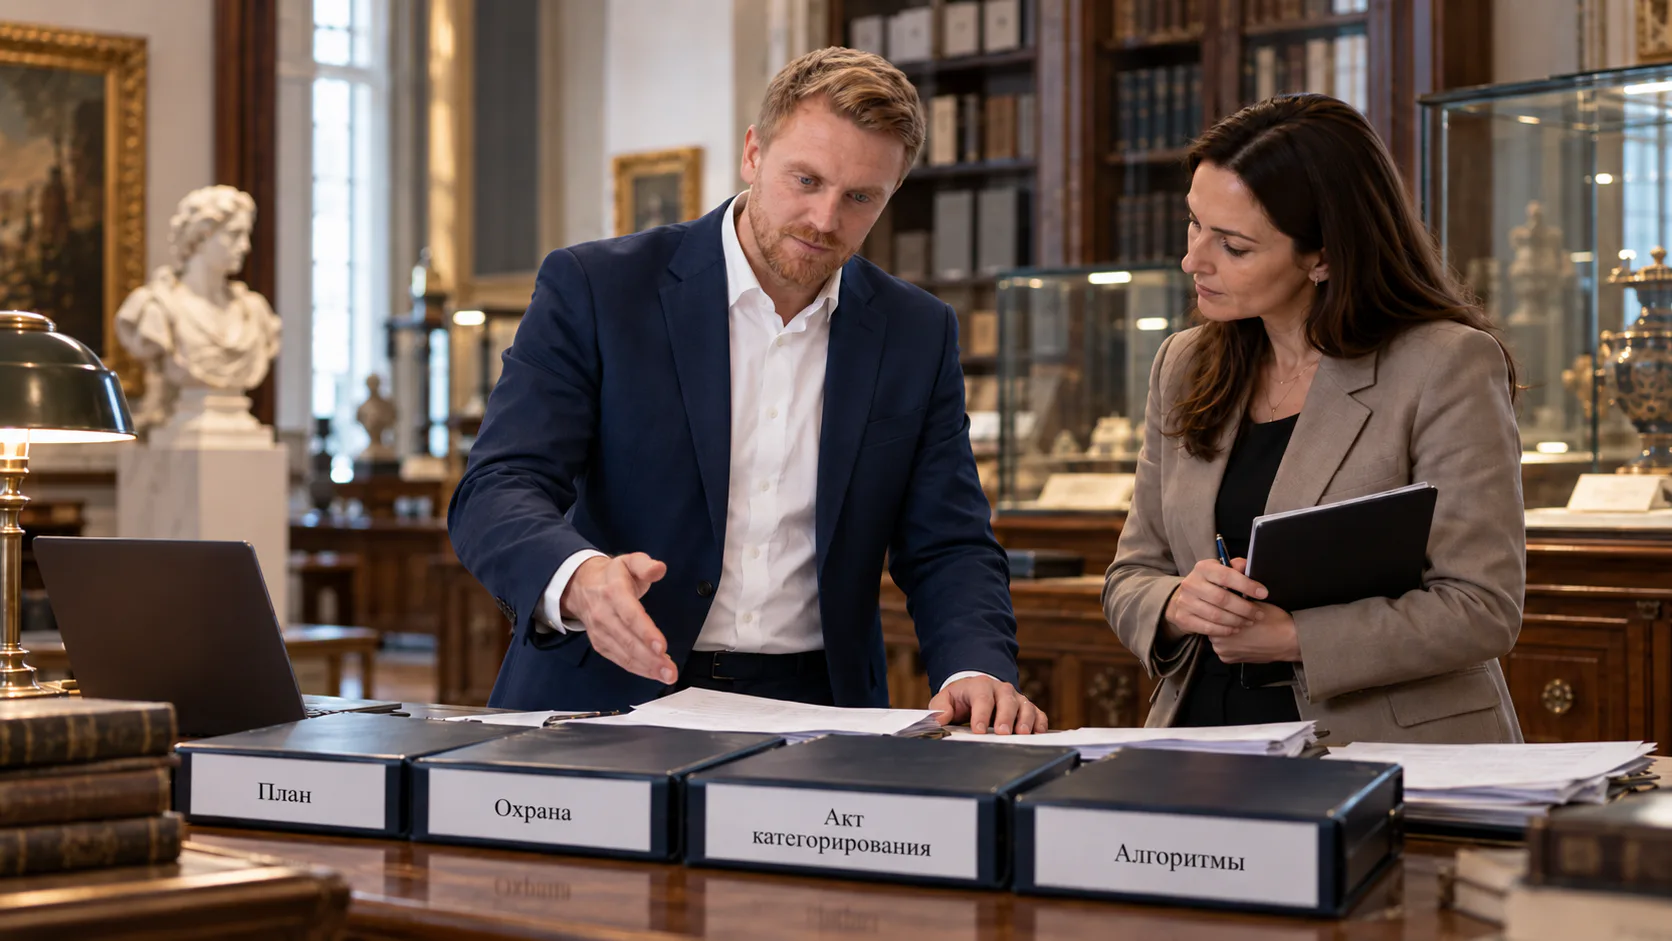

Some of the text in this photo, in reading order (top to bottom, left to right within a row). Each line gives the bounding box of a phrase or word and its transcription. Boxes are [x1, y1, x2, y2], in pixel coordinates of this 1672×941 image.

[258, 782, 312, 804] План
[494, 798, 572, 824] Охрана
[824, 807, 865, 827] Акт
[752, 830, 931, 857] категорирования
[1114, 843, 1245, 872] Алгоритмы
